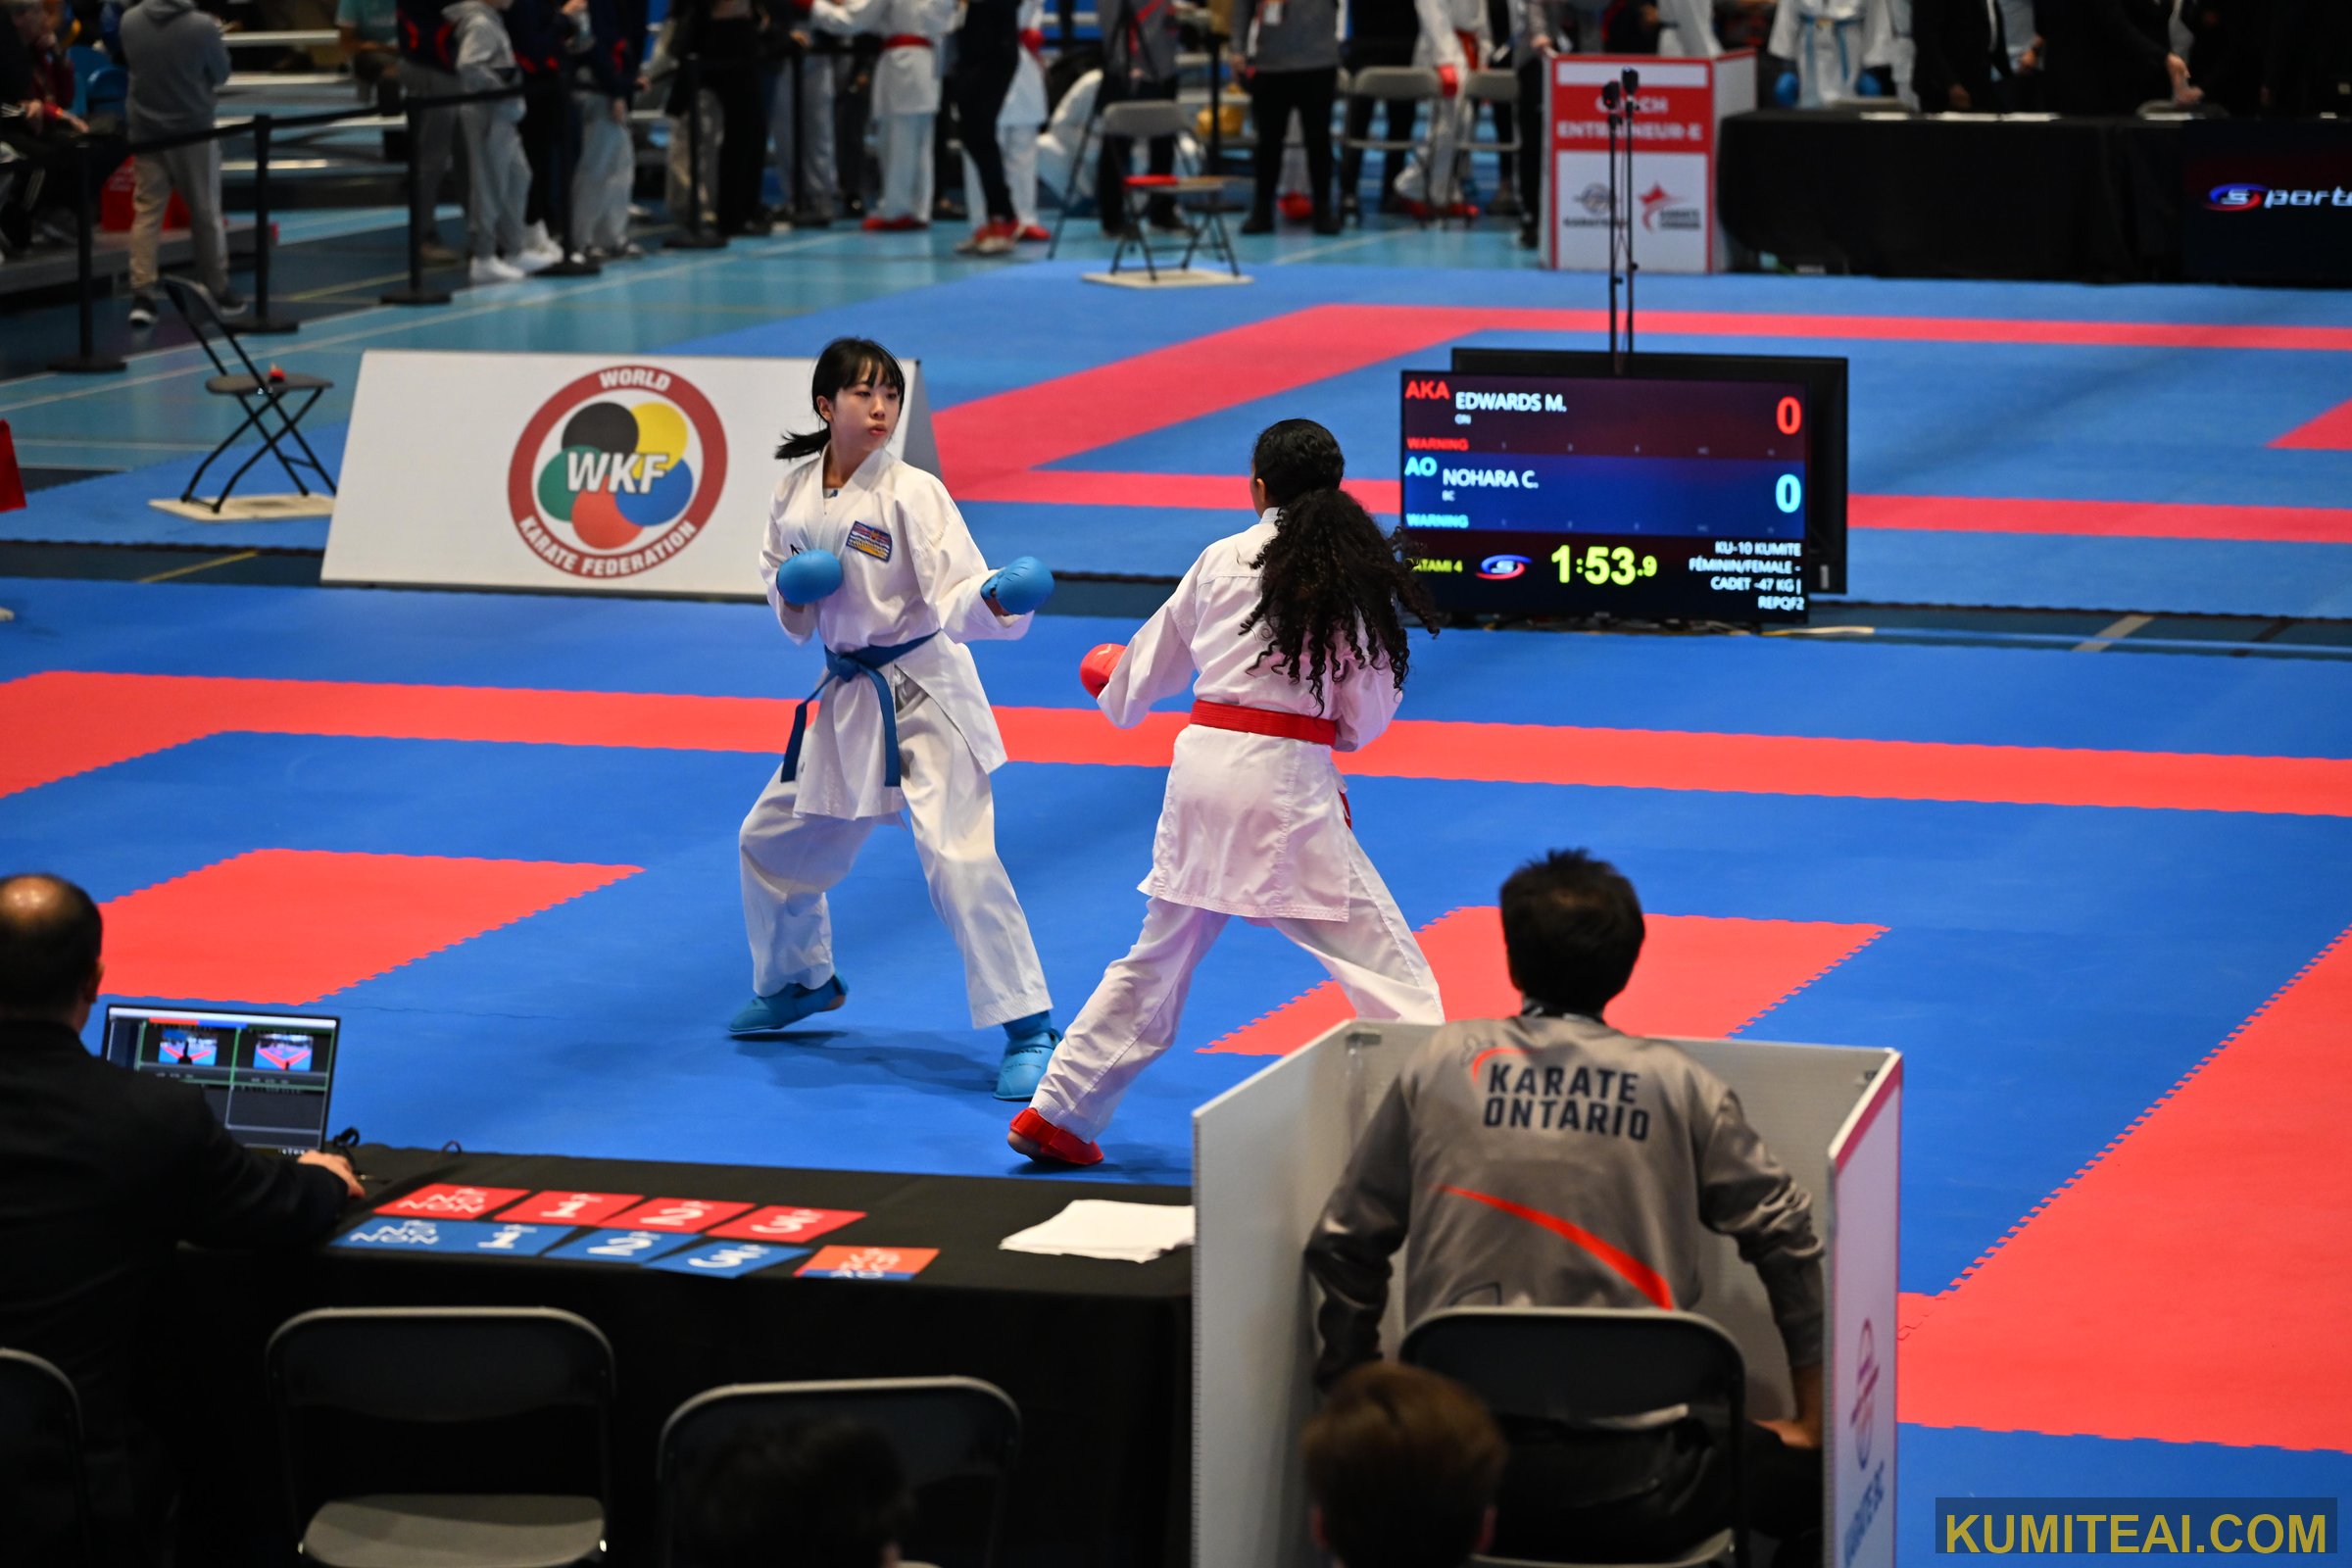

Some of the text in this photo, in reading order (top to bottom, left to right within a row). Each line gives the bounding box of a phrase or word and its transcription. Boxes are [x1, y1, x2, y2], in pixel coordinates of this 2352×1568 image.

[1595, 96, 1669, 114] CCH
[599, 368, 672, 392] WORLD
[1404, 379, 1450, 400] AKA
[1454, 391, 1567, 413] EDWARDS M.
[1776, 396, 1802, 435] 0
[1406, 436, 1469, 452] WARNING
[566, 451, 670, 494] WKF
[1403, 456, 1438, 477] AO
[1442, 467, 1540, 489] NOHARA C.
[1775, 473, 1802, 514] 0
[1405, 513, 1469, 529] WARNING
[518, 514, 698, 576] KARATE FEDERATION
[1715, 541, 1802, 557] KU-10 KUMITE
[1406, 558, 1463, 573] ATAMI 4
[1710, 575, 1752, 591] CADET
[1776, 578, 1794, 592] KG
[1488, 1063, 1640, 1104] KARATE
[1483, 1097, 1651, 1142] ONTARIO
[640, 1207, 704, 1226] 2
[750, 1214, 819, 1234] 3
[477, 1232, 521, 1250] 1
[586, 1237, 653, 1256] 2
[688, 1249, 764, 1268] 3
